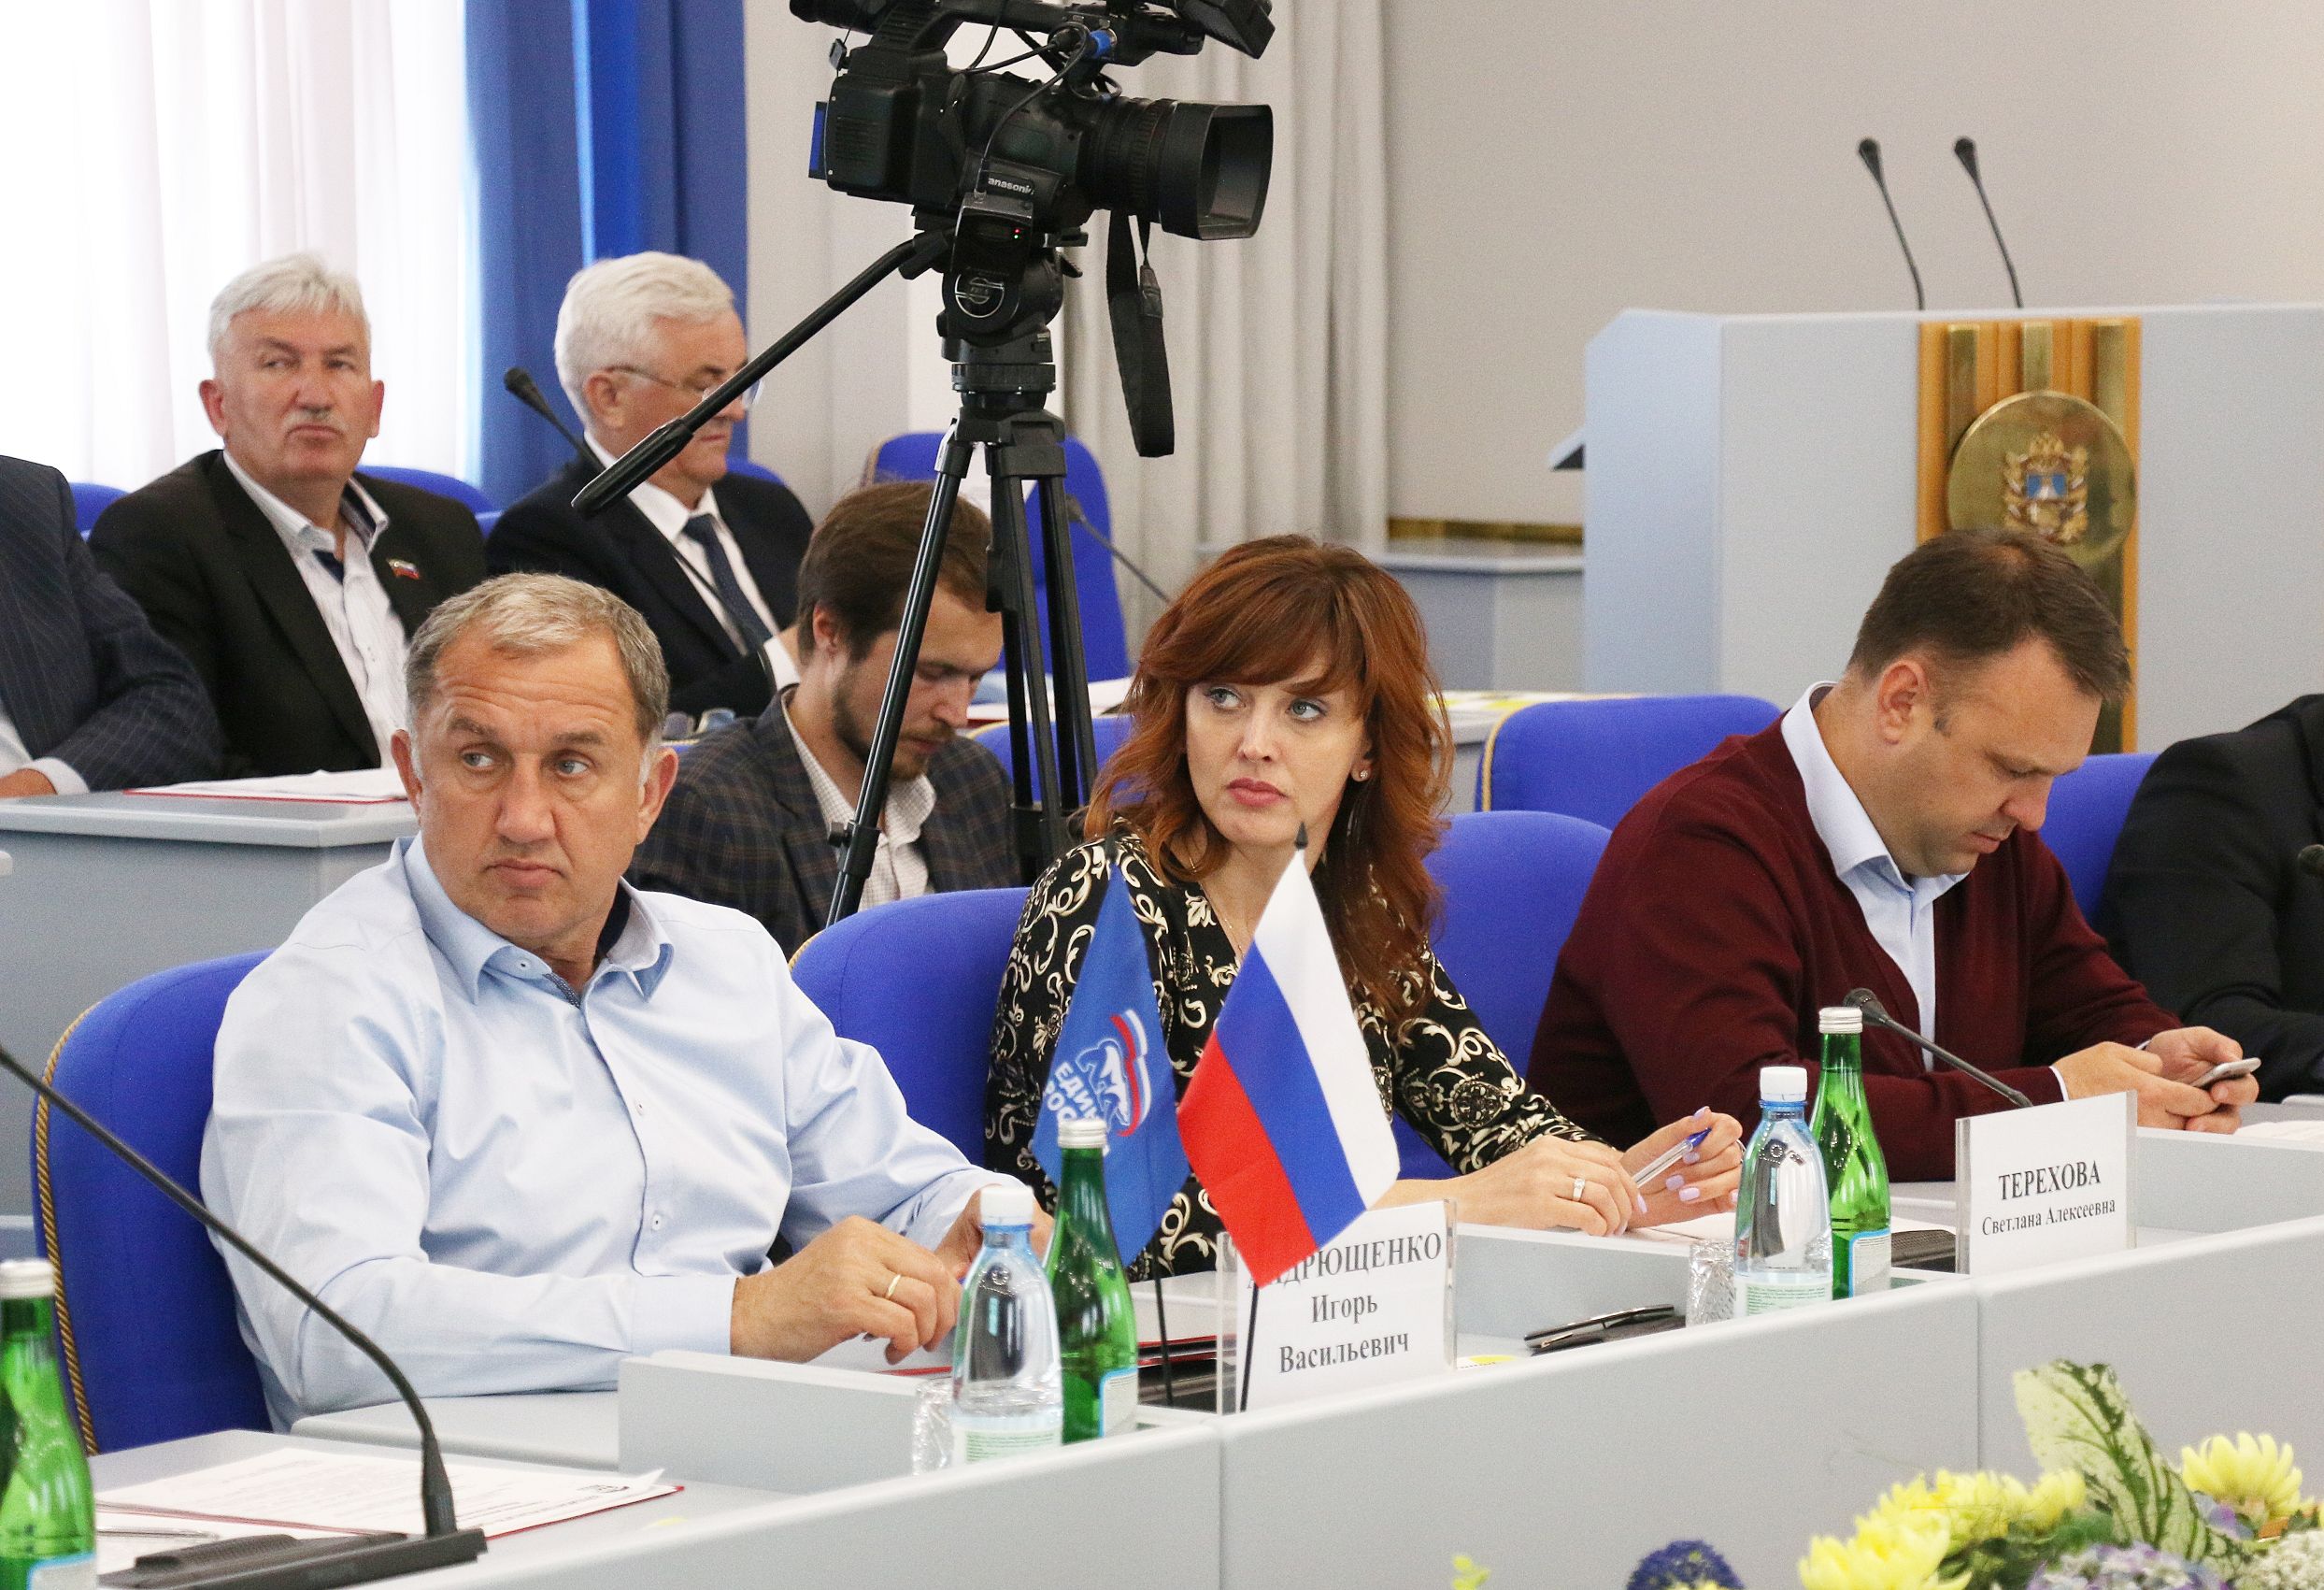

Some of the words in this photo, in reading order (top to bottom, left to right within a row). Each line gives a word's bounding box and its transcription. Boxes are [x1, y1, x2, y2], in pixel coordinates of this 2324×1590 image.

[987, 178, 1034, 195] anasoni
[1999, 1160, 2101, 1201] ТЕРЕХОВА
[1982, 1212, 2042, 1236] Светлана
[2046, 1199, 2117, 1225] Алексеевна
[1248, 1232, 1441, 1289] ДРЮЩЕНКО
[1311, 1295, 1378, 1324] Игорь
[1279, 1333, 1409, 1373] Васильевич
